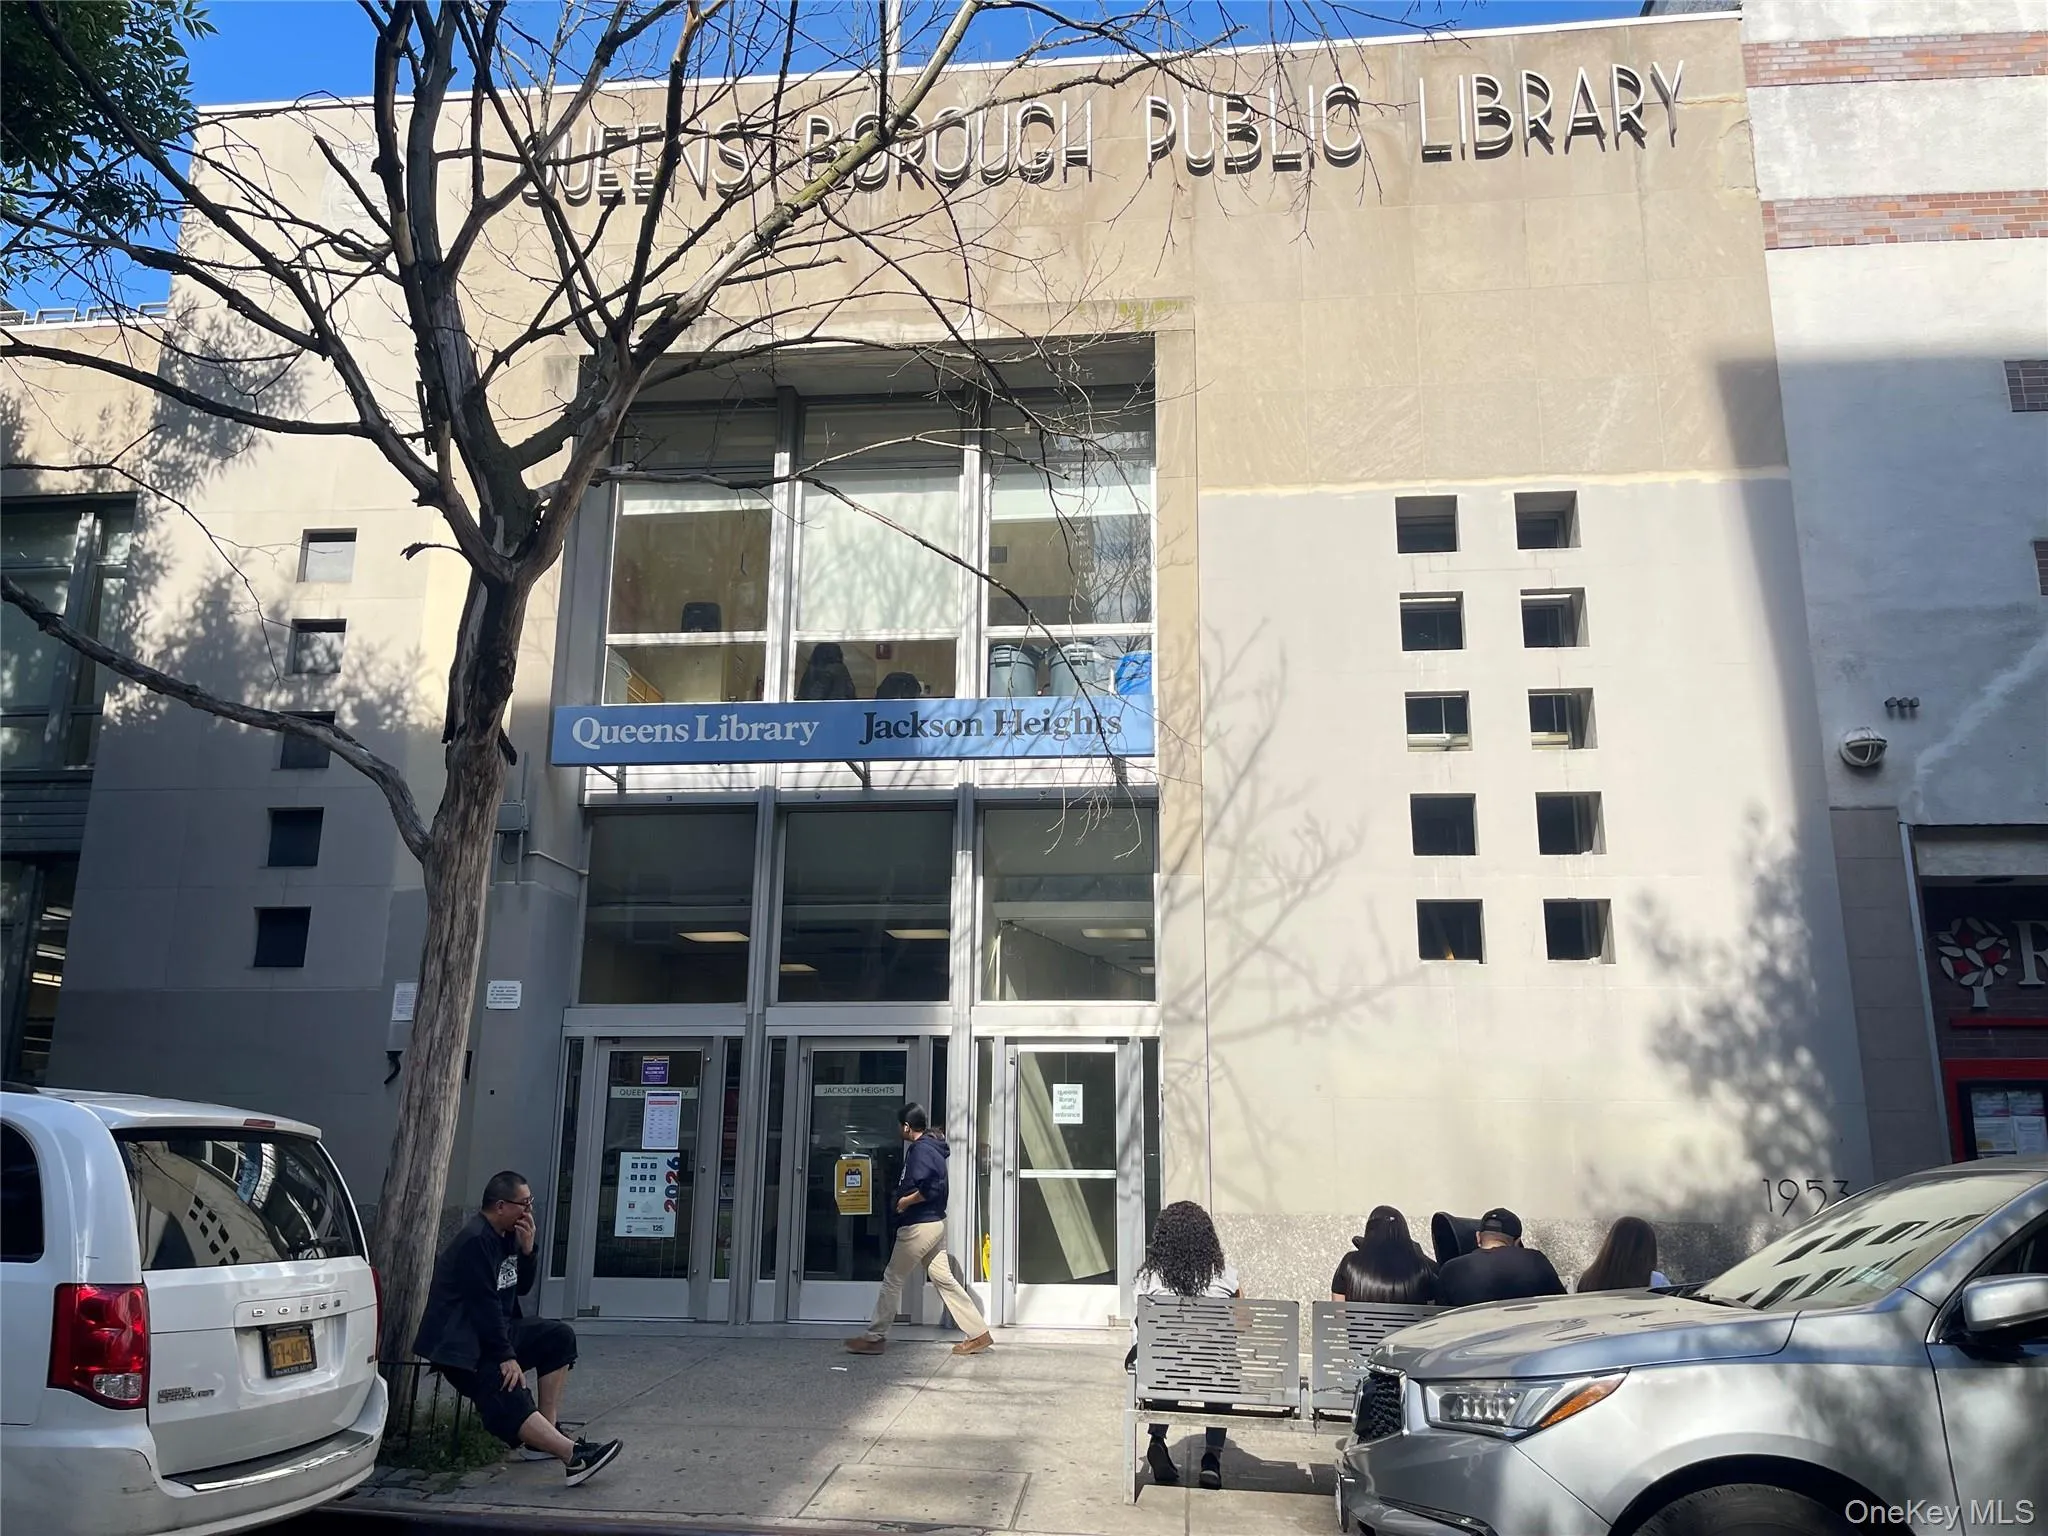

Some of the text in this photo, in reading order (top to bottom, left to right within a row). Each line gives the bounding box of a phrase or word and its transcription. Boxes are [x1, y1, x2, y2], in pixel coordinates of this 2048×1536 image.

[804, 100, 1093, 190] BOROUGH
[1146, 83, 1362, 173] PUBLIC
[1418, 60, 1685, 161] LIBRARY
[572, 708, 1123, 749] Queens Library Jackson Heights
[619, 1088, 649, 1096] QUEEN
[823, 1086, 895, 1095] JACKSON HEIGHTS
[664, 1156, 681, 1213] 2026
